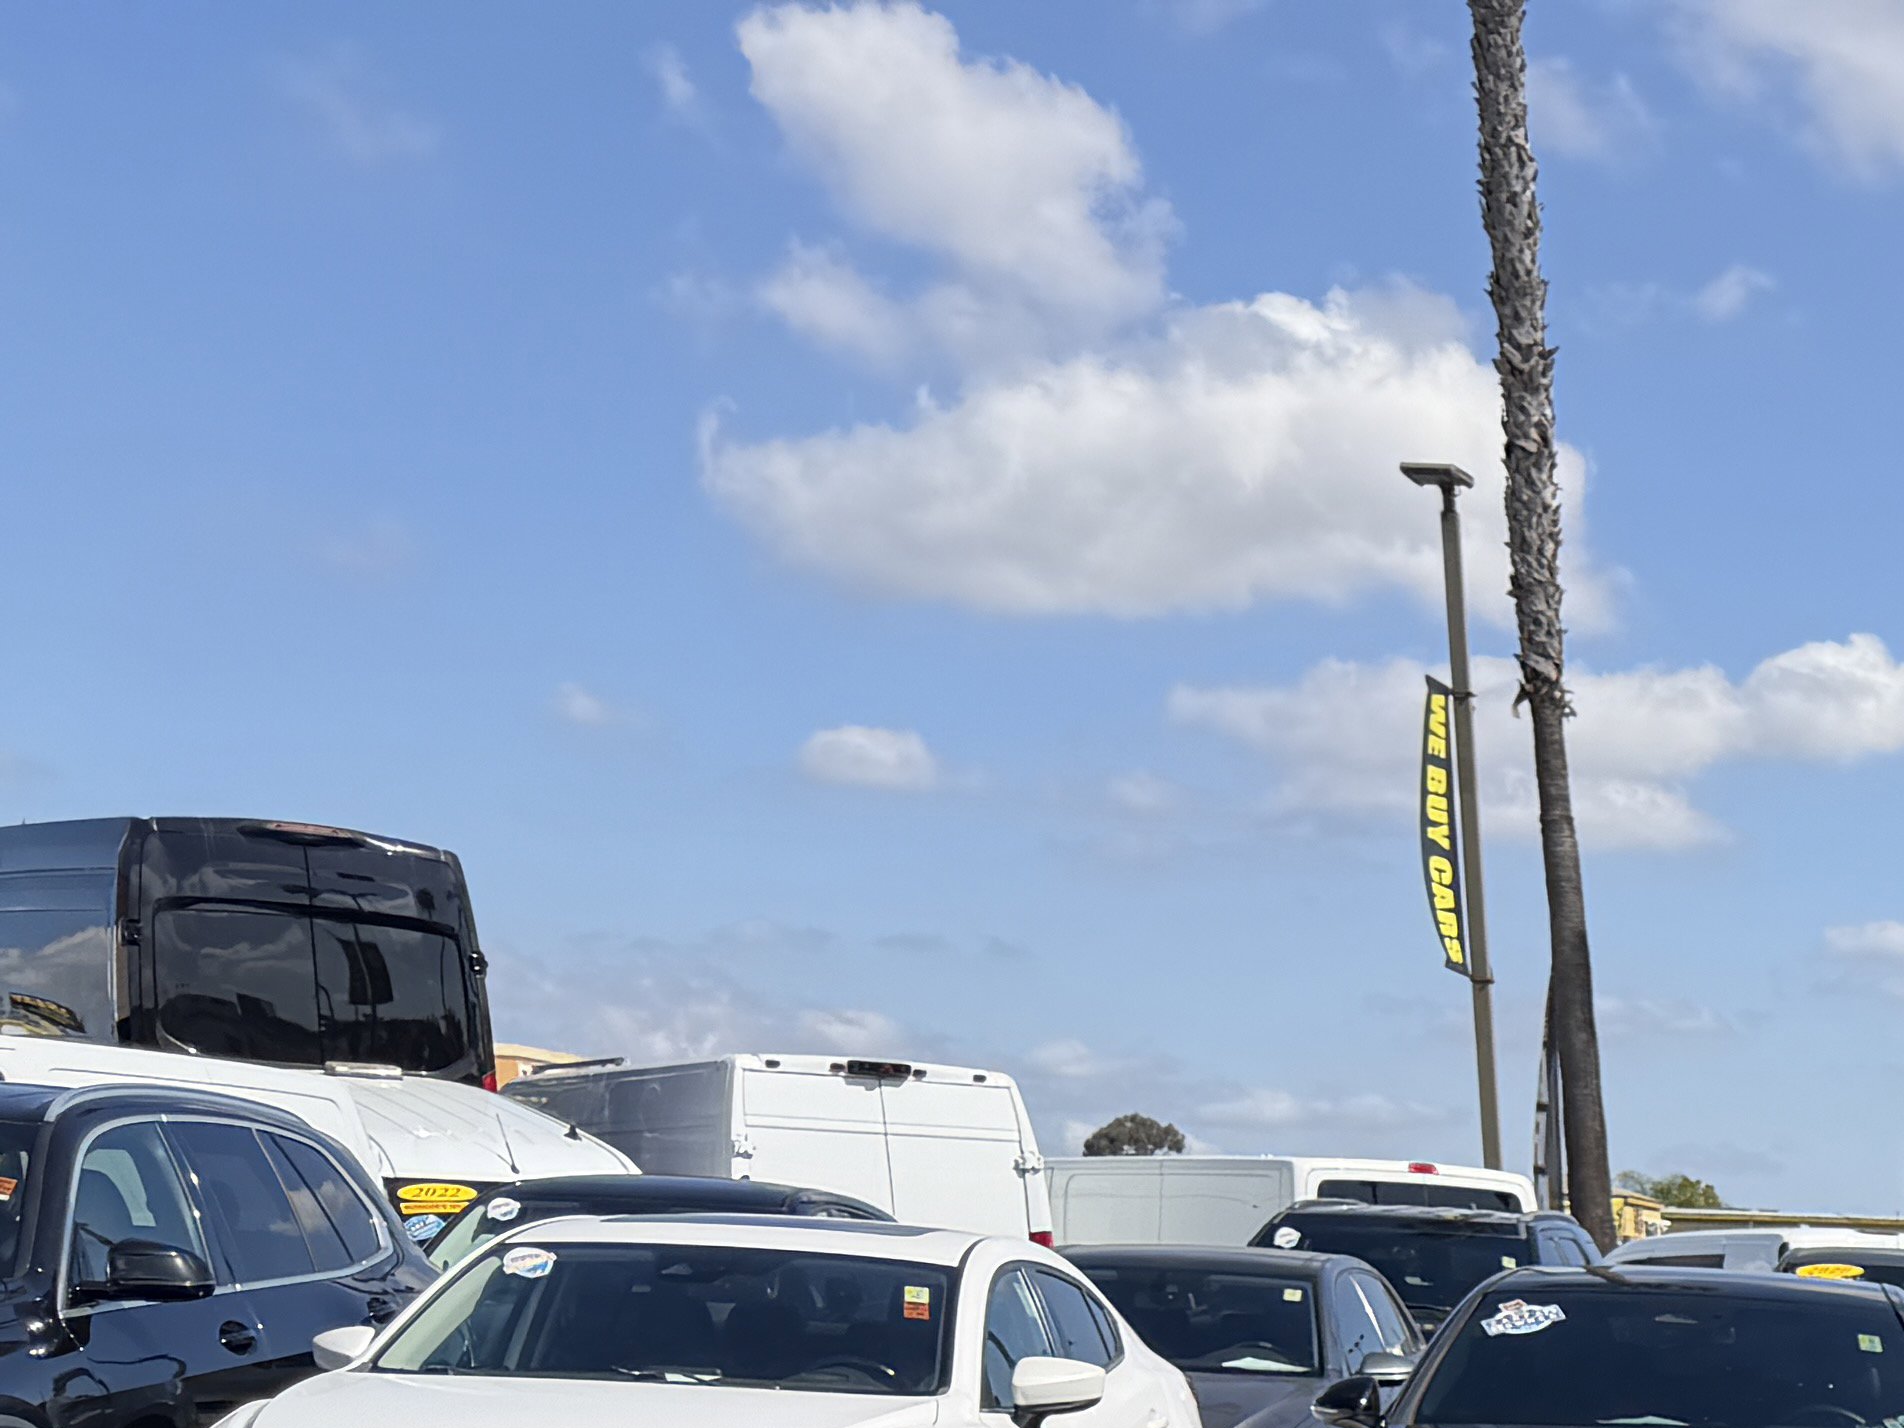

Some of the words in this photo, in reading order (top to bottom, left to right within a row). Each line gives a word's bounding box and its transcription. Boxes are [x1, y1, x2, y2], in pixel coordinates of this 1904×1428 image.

[1427, 693, 1447, 759] WE
[1426, 764, 1451, 851] BUY
[1428, 855, 1464, 965] CARS
[411, 1187, 462, 1198] 2022
